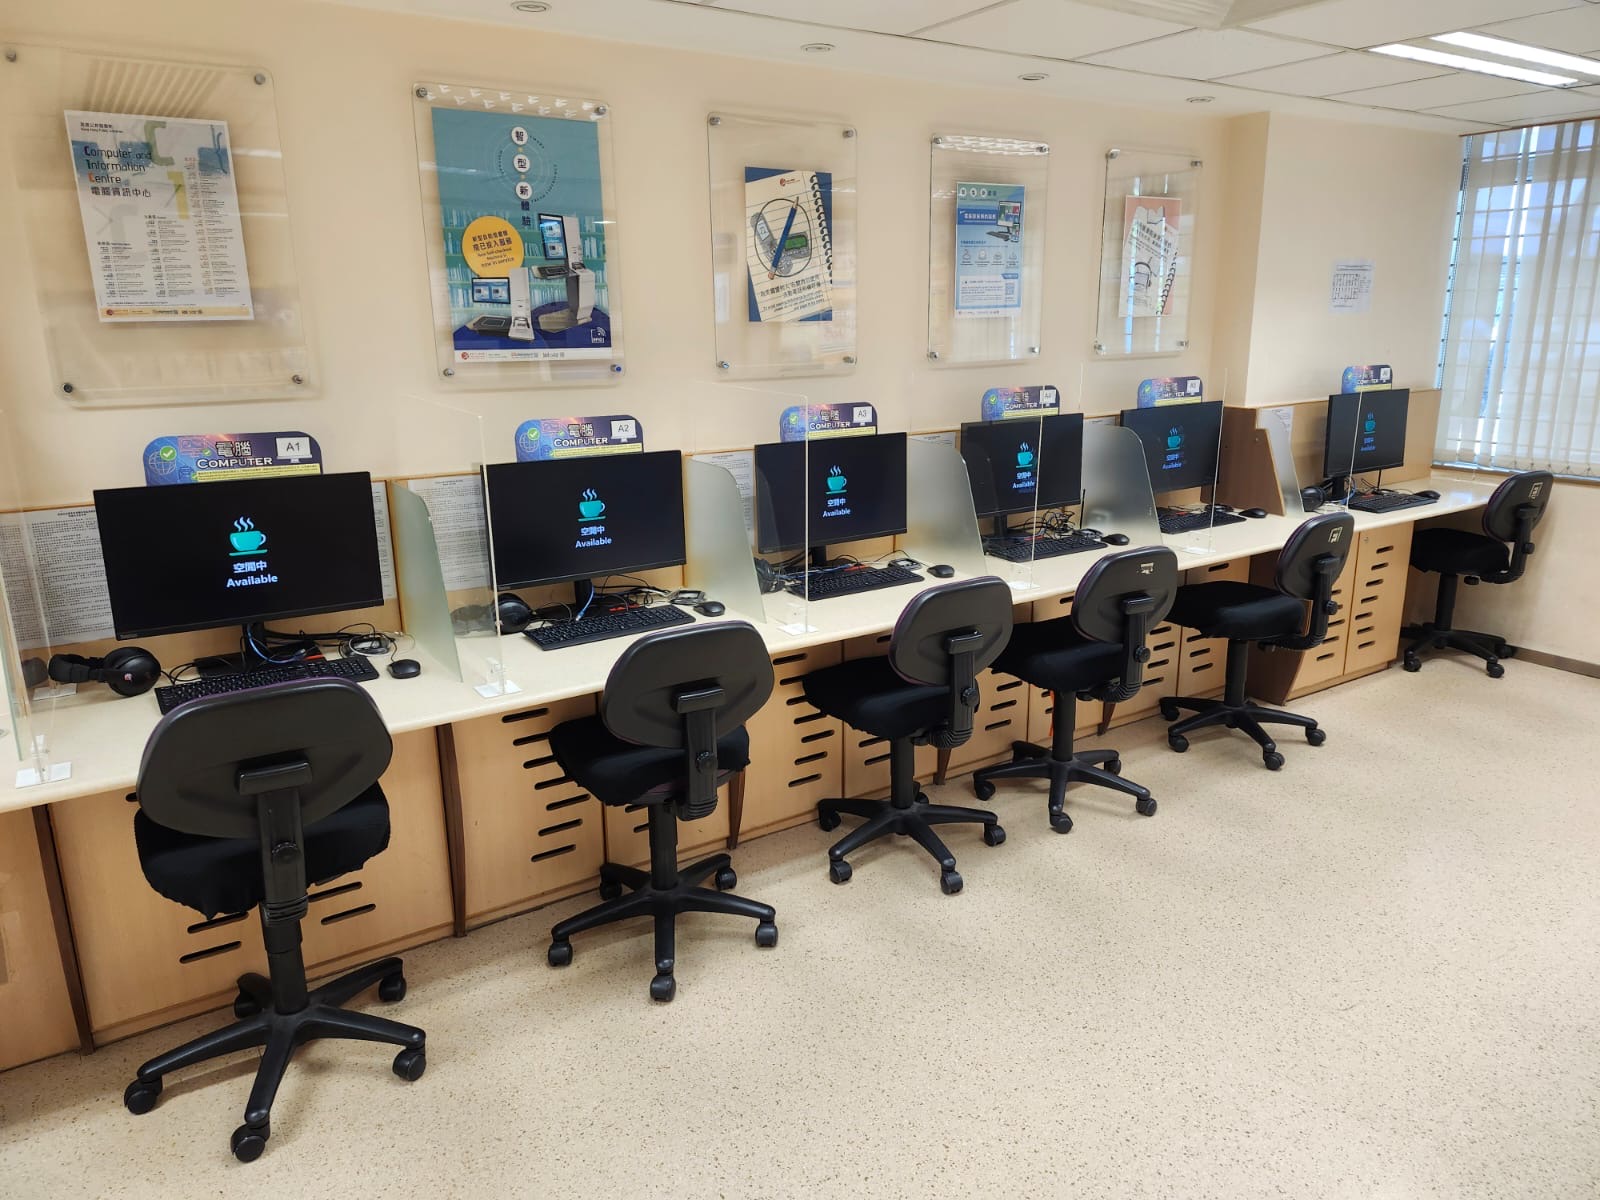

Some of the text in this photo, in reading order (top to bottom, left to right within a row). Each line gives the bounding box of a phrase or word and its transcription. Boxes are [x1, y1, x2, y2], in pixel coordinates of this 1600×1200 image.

[84, 146, 152, 160] Computer and
[86, 159, 146, 172] Information
[88, 171, 122, 184] Centre
[91, 186, 152, 198] 電腦資訊中心
[857, 410, 867, 418] A3
[617, 424, 629, 433] A2
[809, 421, 850, 430] COMPUTER
[554, 438, 608, 447] COMPUTER
[216, 441, 300, 457] 電腦 A1
[197, 457, 272, 469] COMPUTER
[1012, 481, 1036, 489] Available
[822, 508, 851, 518] Available
[575, 537, 612, 548] Available
[226, 574, 278, 588] Available
